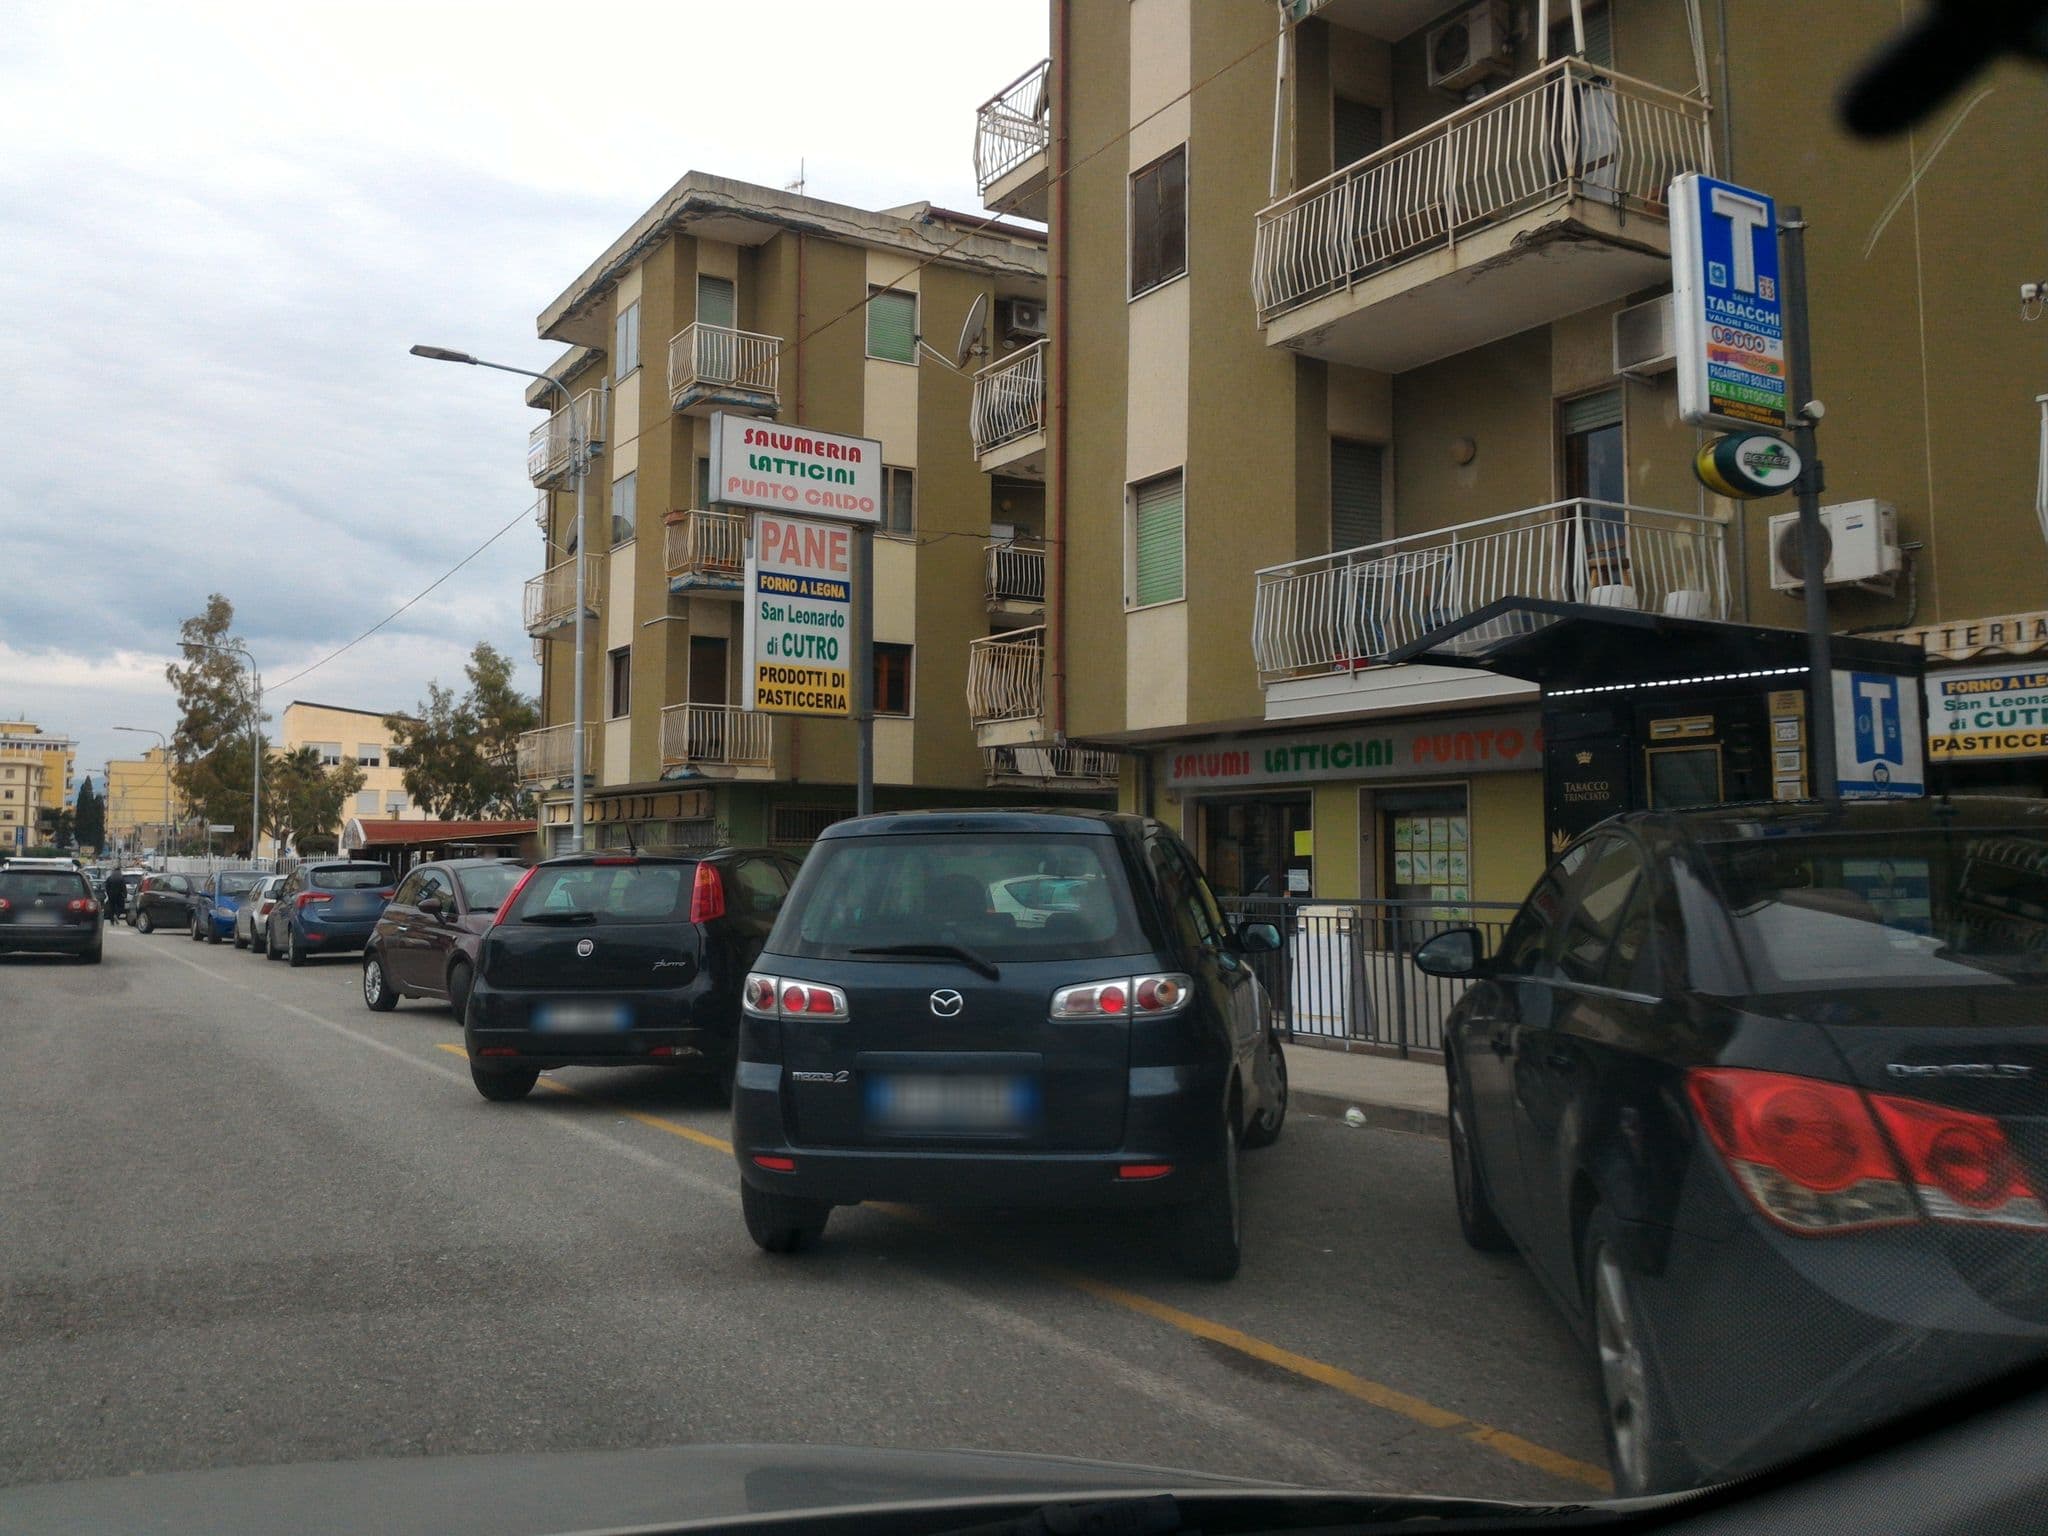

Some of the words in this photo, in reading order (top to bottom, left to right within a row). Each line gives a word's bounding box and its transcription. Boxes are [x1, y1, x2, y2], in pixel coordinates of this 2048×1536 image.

[1711, 187, 1768, 293] T
[1707, 295, 1780, 327] TABACCHI
[1708, 313, 1742, 327] VALORI
[1743, 322, 1780, 337] BOLLATI
[1712, 325, 1765, 353] LOTTO
[1709, 364, 1750, 384] PAGAMENTO
[1750, 375, 1783, 393] BOLLETTE
[1711, 381, 1727, 393] FAX
[744, 427, 862, 463] SALUMERIA
[749, 453, 856, 485] LATTICINI
[728, 475, 799, 502] PUNTO
[804, 487, 875, 513] CALDO
[761, 520, 848, 573] PANE
[760, 574, 797, 594] FORNO
[800, 580, 809, 594] A
[809, 582, 846, 599] LEGNA
[761, 601, 784, 622] San
[788, 604, 845, 628] Leonardo
[767, 636, 780, 657] di
[782, 632, 839, 661] CUTRO
[759, 666, 827, 688] PRODOTTI
[832, 672, 845, 688] DI
[1946, 677, 2003, 695] FORNO
[2007, 676, 2020, 690] A
[2024, 673, 2048, 688] LE
[758, 687, 847, 711] PASTICCERIA
[1944, 699, 1981, 711] San
[1948, 718, 1967, 730] di
[1174, 750, 1250, 779] SALUMI
[1264, 738, 1394, 773] LATTICINI
[1412, 727, 1525, 764] PUNTO
[1563, 781, 1609, 793] TABACCO
